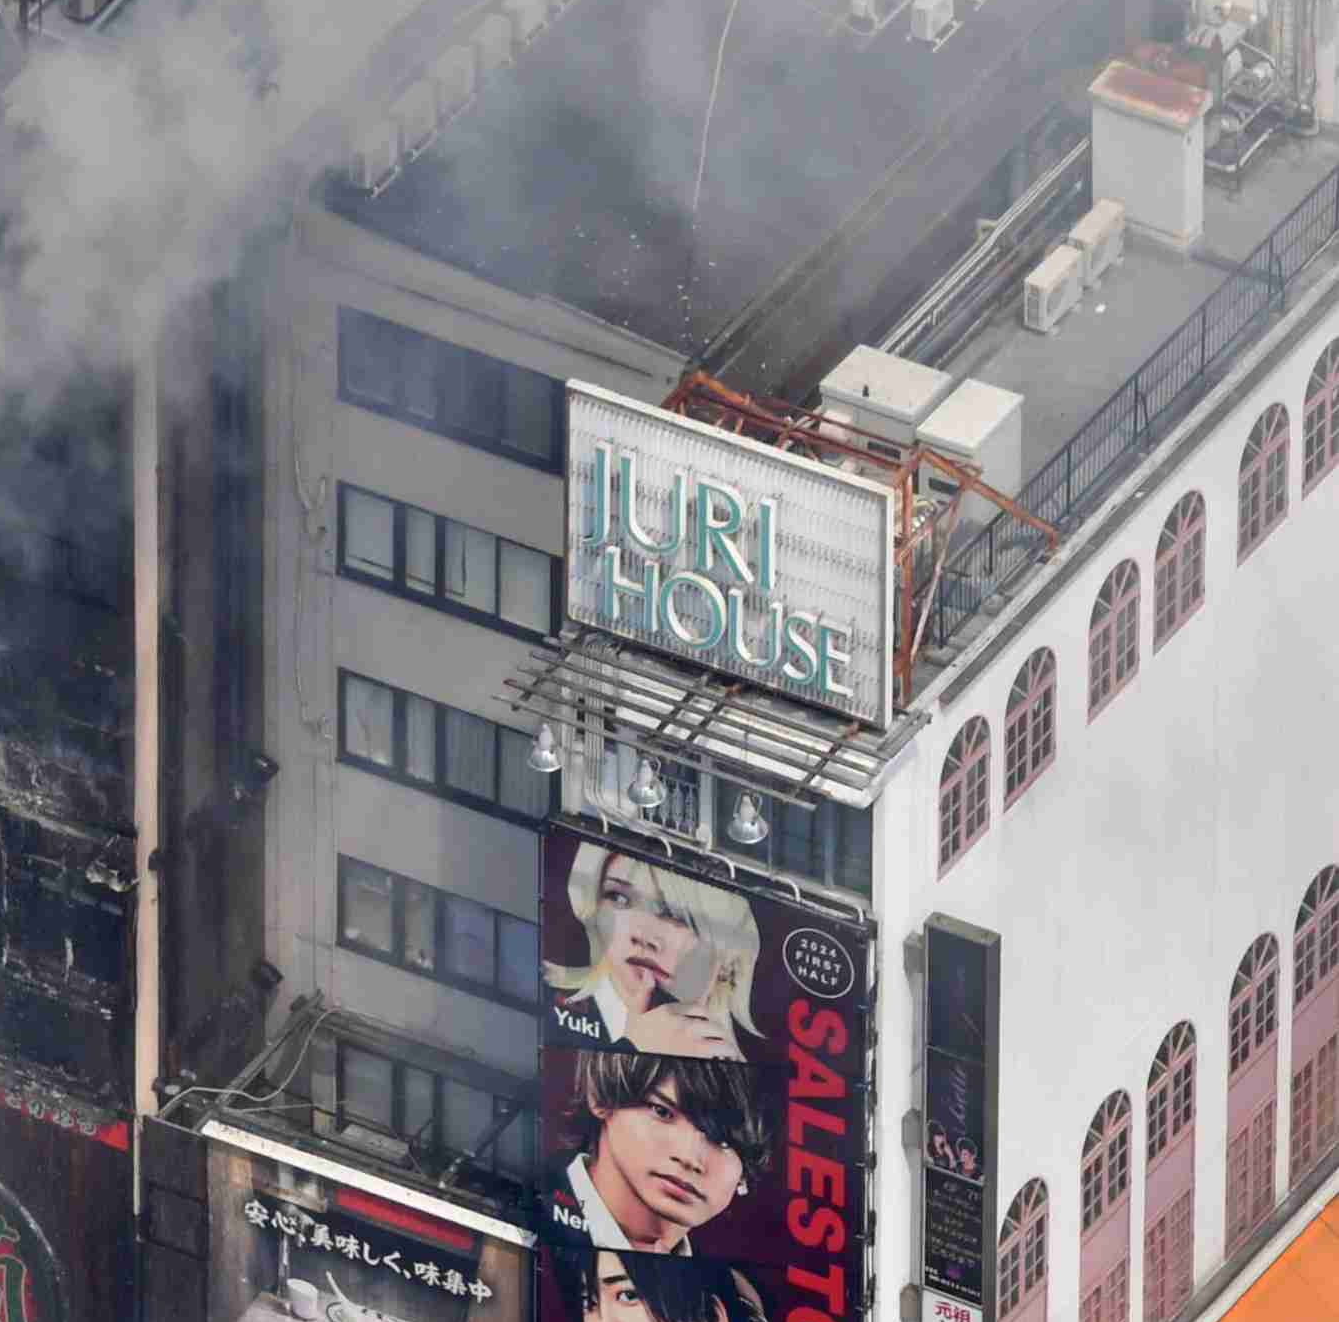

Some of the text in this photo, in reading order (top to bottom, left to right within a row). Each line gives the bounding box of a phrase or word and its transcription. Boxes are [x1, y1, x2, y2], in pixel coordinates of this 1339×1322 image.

[581, 439, 777, 593] JURI
[604, 545, 855, 699] HOUSE
[794, 949, 843, 973] FIRST
[799, 937, 838, 959] 2024
[797, 966, 839, 988] HALF
[554, 1005, 600, 1038] Yuki
[787, 998, 848, 1253] SALES
